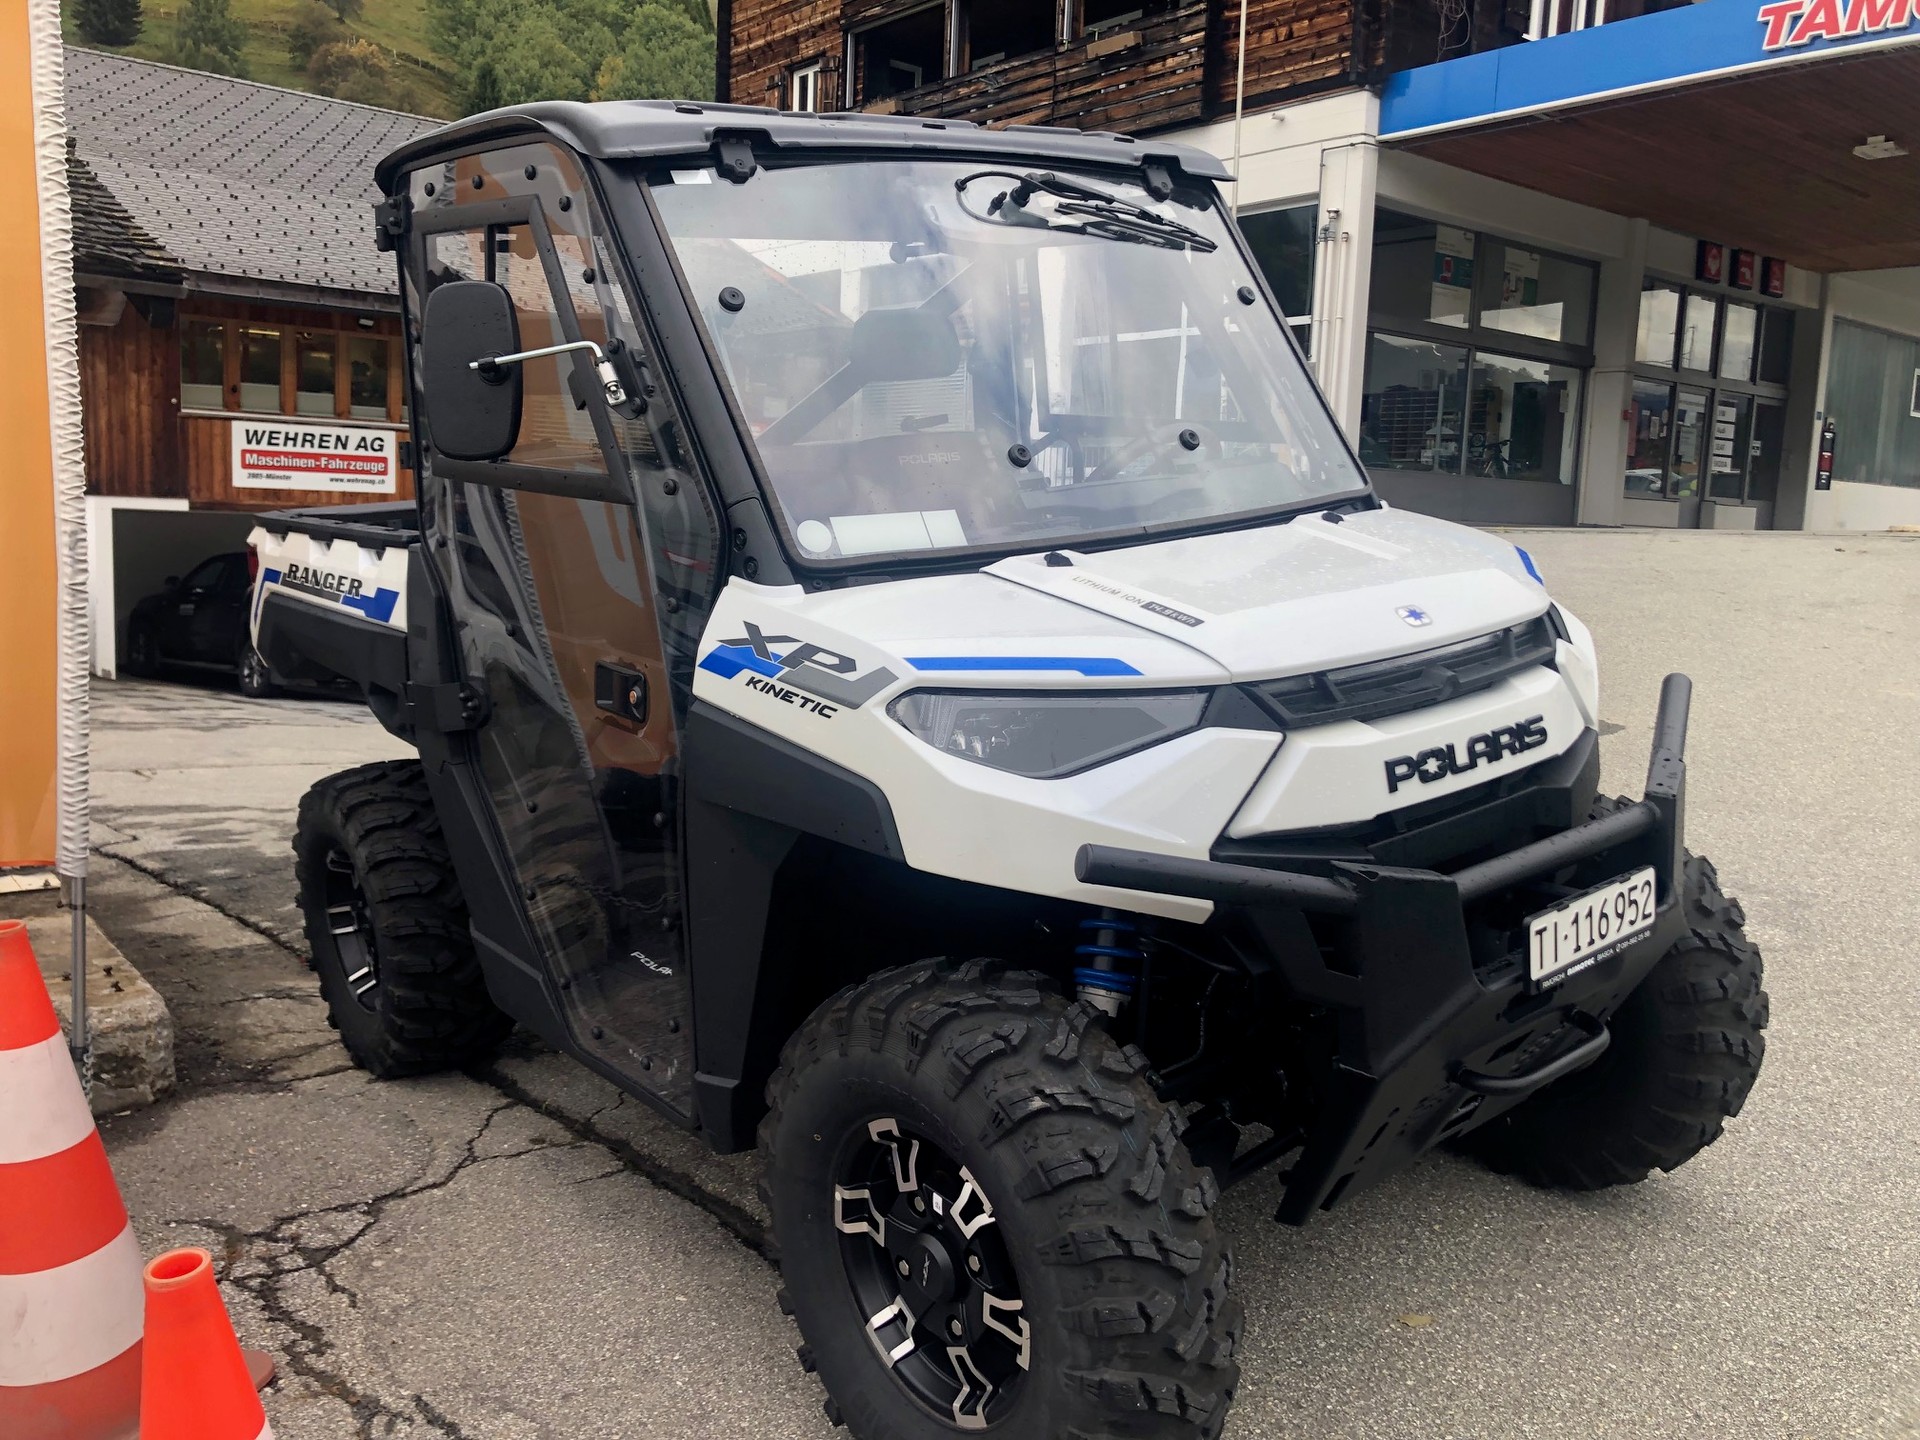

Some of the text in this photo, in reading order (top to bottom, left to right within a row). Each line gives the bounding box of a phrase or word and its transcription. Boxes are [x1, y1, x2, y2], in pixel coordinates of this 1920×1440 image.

[1757, 0, 1920, 50] TAM
[245, 429, 385, 453] WEHREN AG
[245, 453, 386, 473] Maschinen-Fahrzeuge
[898, 452, 961, 466] POLARIS
[286, 563, 363, 598] RANGER
[1072, 575, 1121, 596] LITHIUM
[1121, 593, 1147, 606] ION
[716, 620, 857, 674] XP
[745, 676, 838, 719] KINETIC
[1384, 714, 1548, 794] POLARIS
